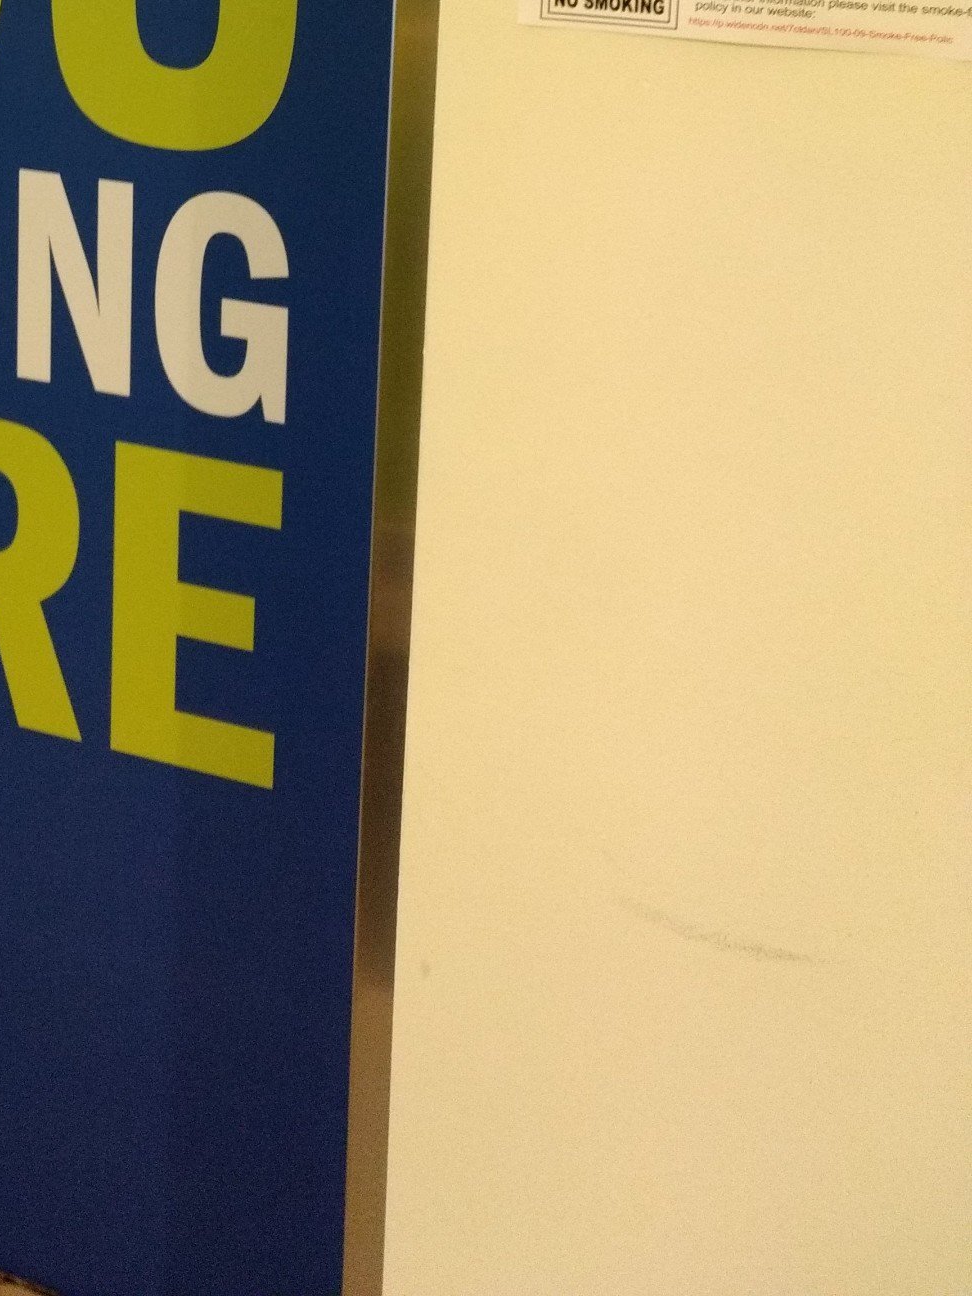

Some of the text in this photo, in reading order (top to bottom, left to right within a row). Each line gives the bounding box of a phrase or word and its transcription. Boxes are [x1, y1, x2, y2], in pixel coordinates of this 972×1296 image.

[695, 1, 728, 14] policy
[731, 3, 742, 13] in
[744, 6, 764, 14] our
[828, 0, 868, 11] please
[871, 2, 896, 12] visit
[898, 2, 918, 14] the
